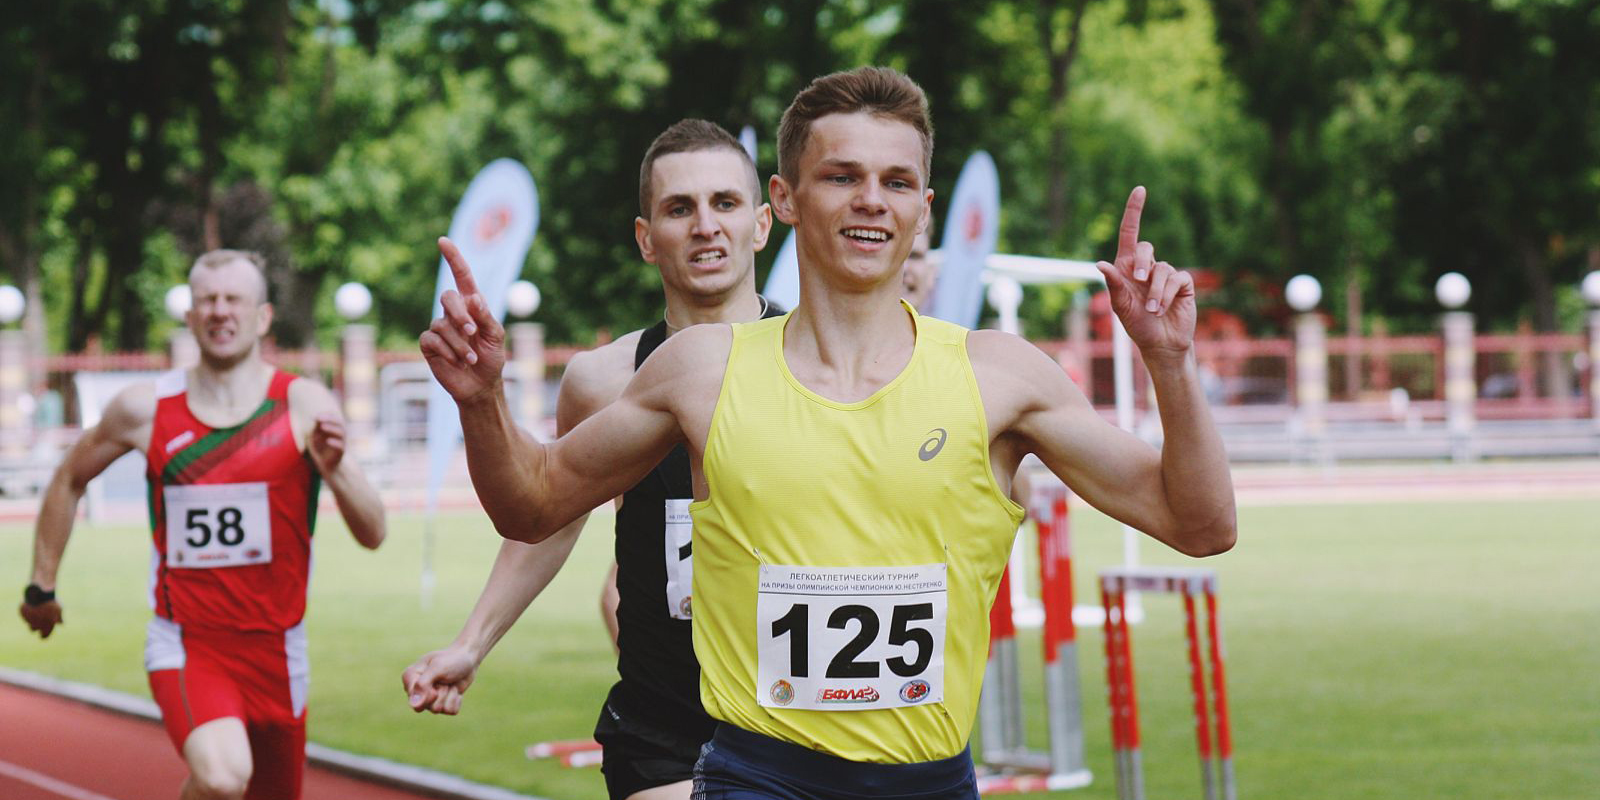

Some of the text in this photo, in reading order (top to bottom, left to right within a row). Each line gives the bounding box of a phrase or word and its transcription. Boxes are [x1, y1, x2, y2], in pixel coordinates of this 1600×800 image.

[185, 507, 245, 548] 58
[790, 572, 920, 582] ЛЕГКОАТЛЕТИЧЕСКИЙ ТУРНИР
[772, 582, 795, 590] ПРИЗЫ
[796, 583, 849, 591] ОЛИМПИЙСКОЙ
[771, 602, 935, 679] 125
[822, 688, 865, 700] БФЛА
